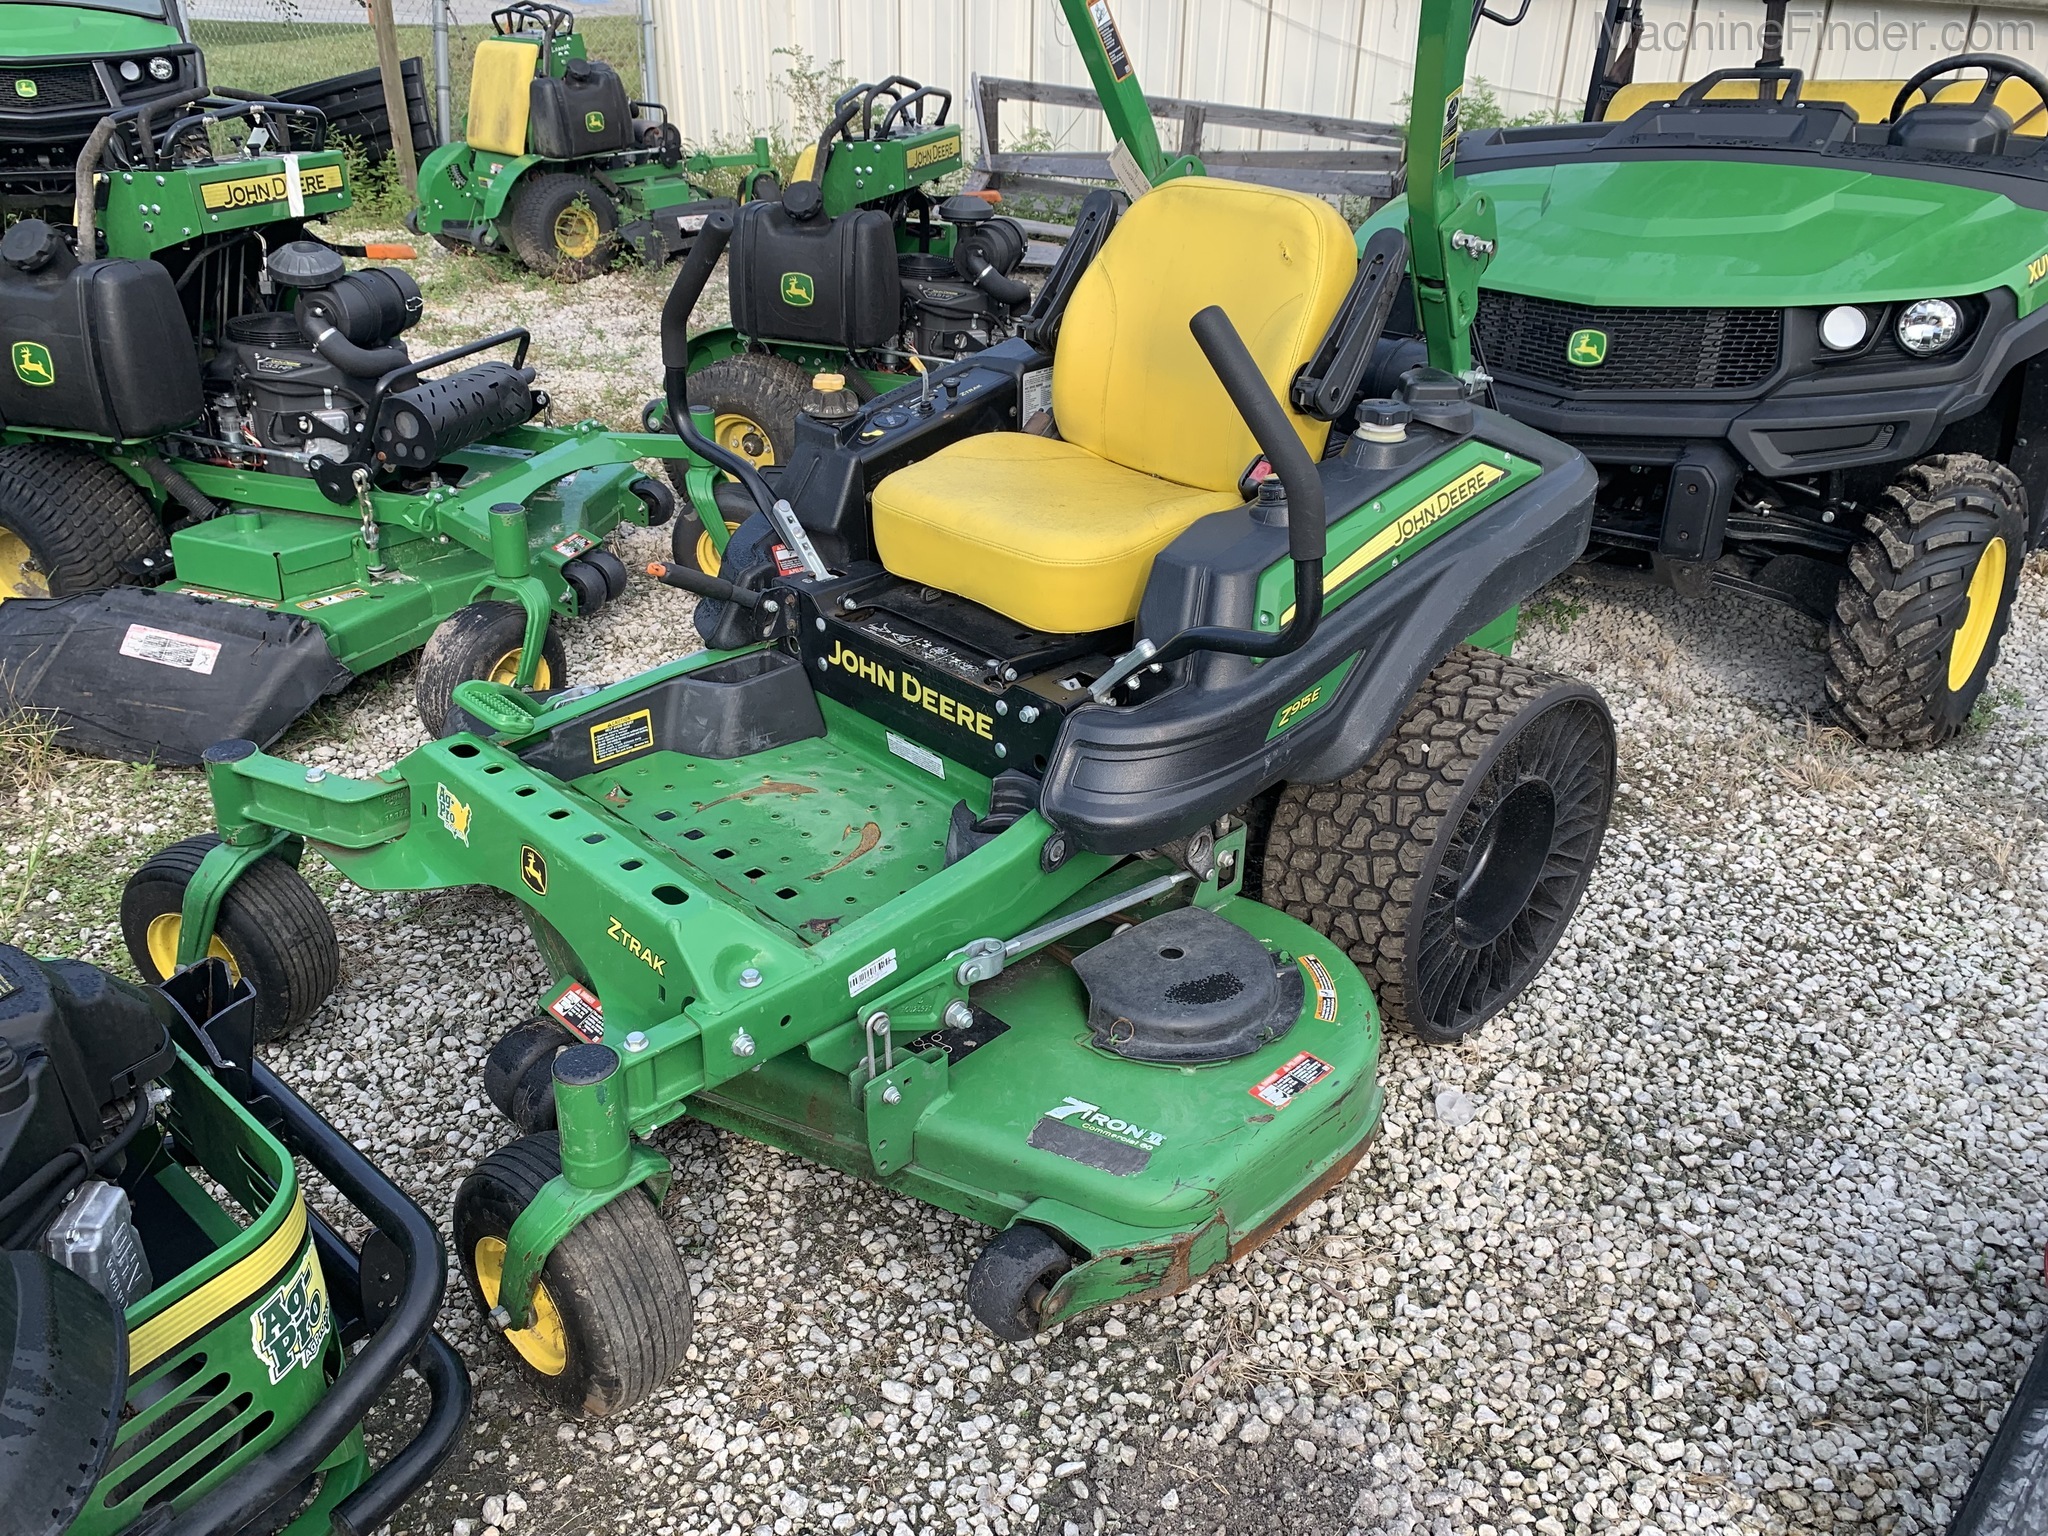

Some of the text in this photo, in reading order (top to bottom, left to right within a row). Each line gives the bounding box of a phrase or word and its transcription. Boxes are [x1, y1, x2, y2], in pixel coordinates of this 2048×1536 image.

[914, 143, 953, 166] JOHN DEERE
[224, 183, 270, 206] JOHN
[2027, 253, 2048, 285] XU
[1395, 471, 1487, 544] JOHN DEERE
[828, 640, 993, 741] JOHN DEERE
[1278, 686, 1322, 728] Z915E
[607, 915, 666, 977] ZTRAK
[1081, 1122, 1139, 1146] Commercial
[268, 1290, 321, 1377] Pro
